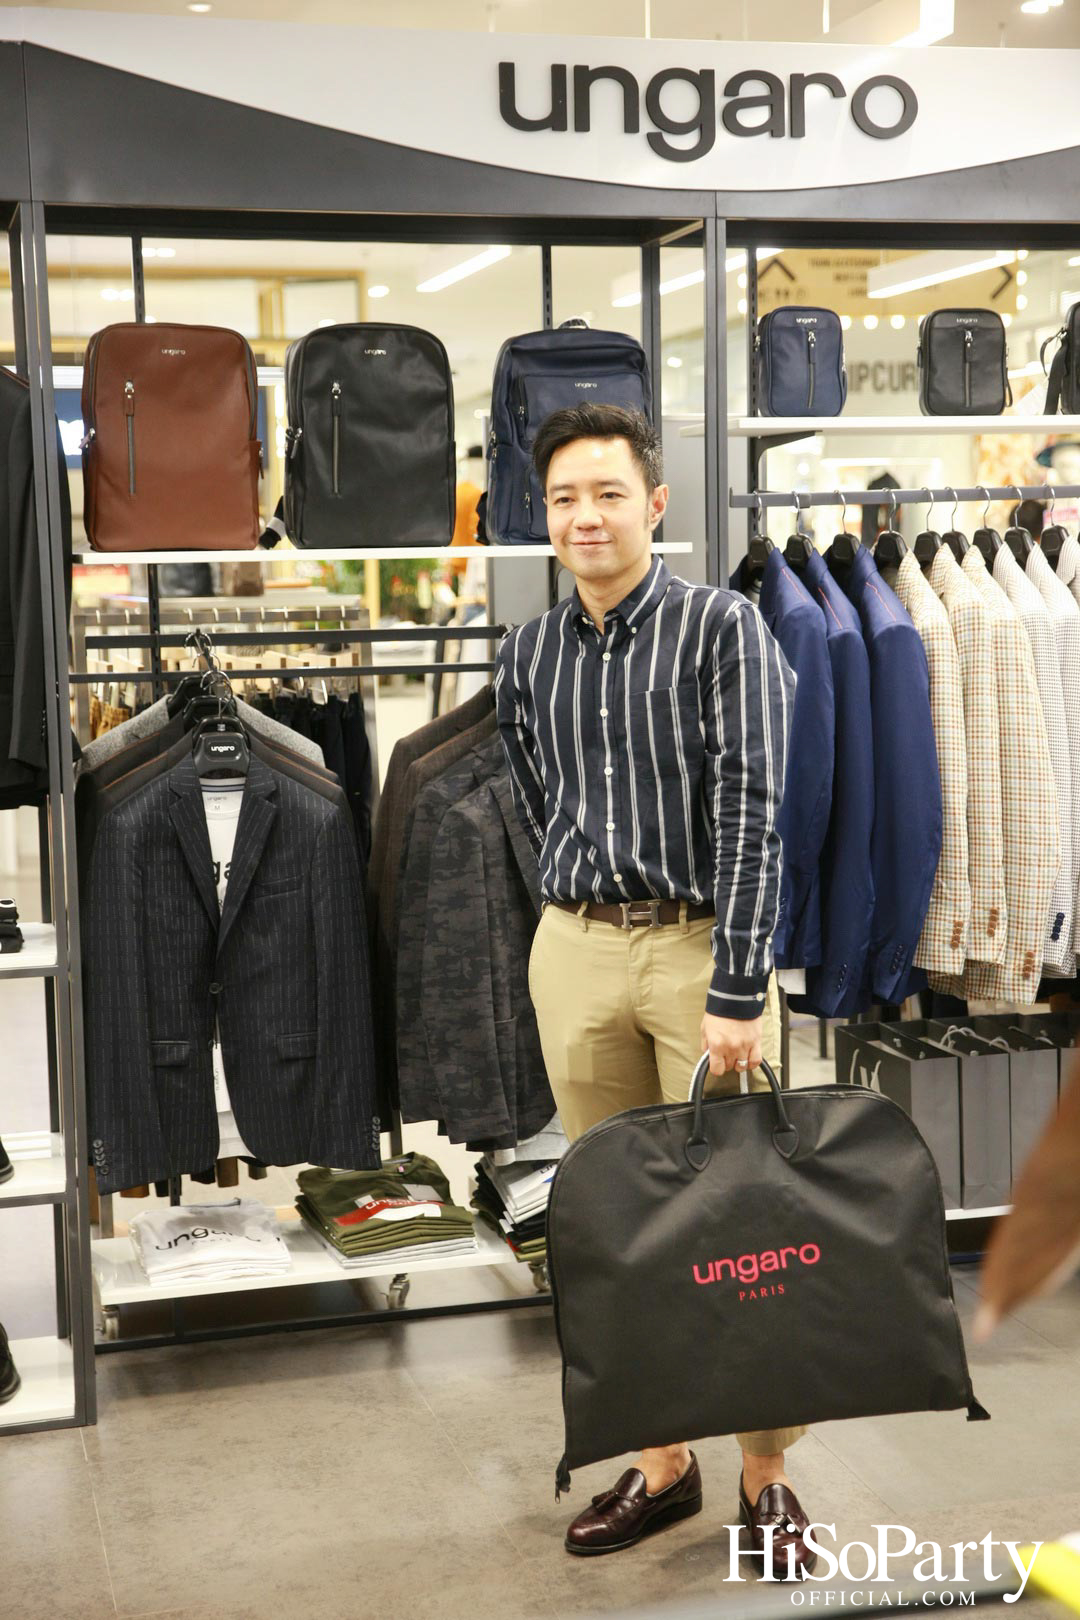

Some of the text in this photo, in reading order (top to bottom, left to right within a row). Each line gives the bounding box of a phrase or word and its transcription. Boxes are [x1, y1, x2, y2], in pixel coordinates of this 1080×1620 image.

[498, 61, 919, 163] ungaro
[848, 360, 919, 392] IPCUR
[210, 745, 235, 753] ungaro
[692, 1242, 821, 1285] ungaro
[738, 1283, 785, 1302] PARIS
